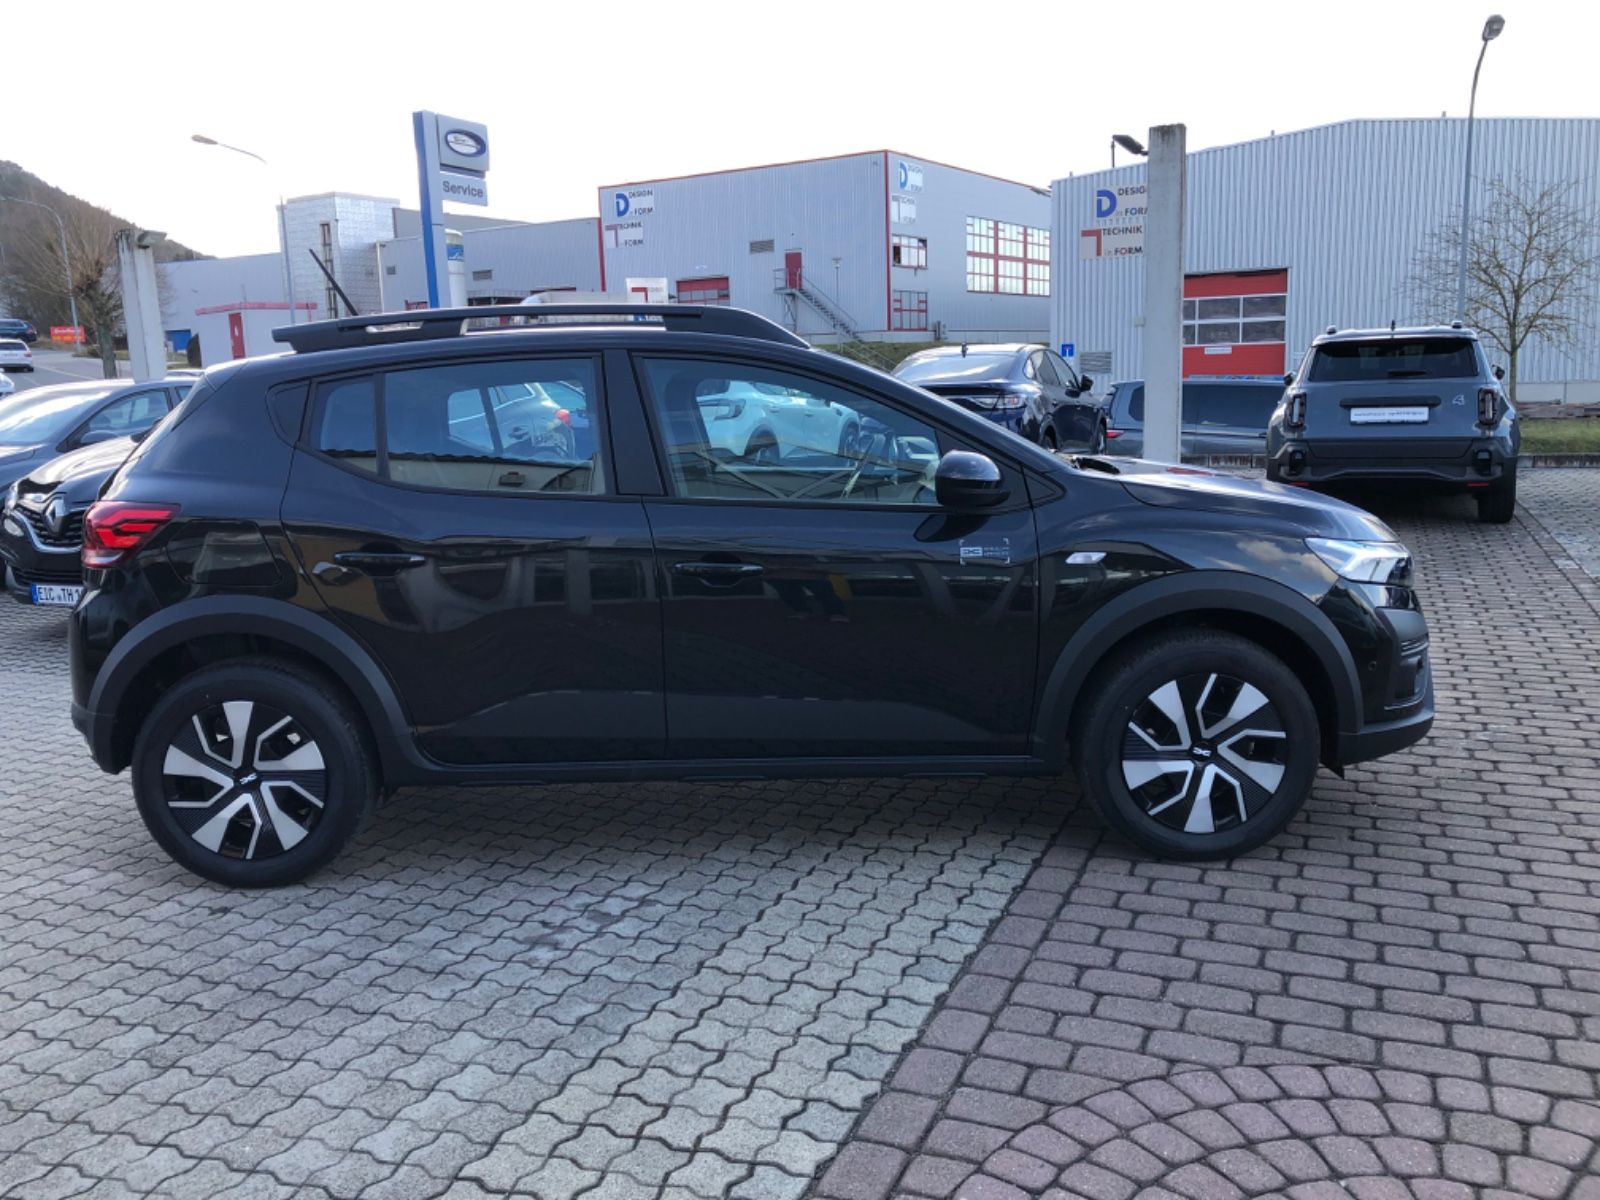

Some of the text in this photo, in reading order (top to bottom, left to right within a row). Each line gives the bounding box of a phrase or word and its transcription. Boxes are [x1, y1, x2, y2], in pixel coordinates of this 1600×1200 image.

[442, 181, 484, 198] Service
[1117, 185, 1147, 196] DESIG
[615, 193, 630, 218] D
[1096, 189, 1117, 218] D
[1102, 225, 1143, 236] TECHNIK
[1114, 246, 1143, 256] FORM
[37, 586, 55, 601] EIC
[60, 588, 74, 602] TH
